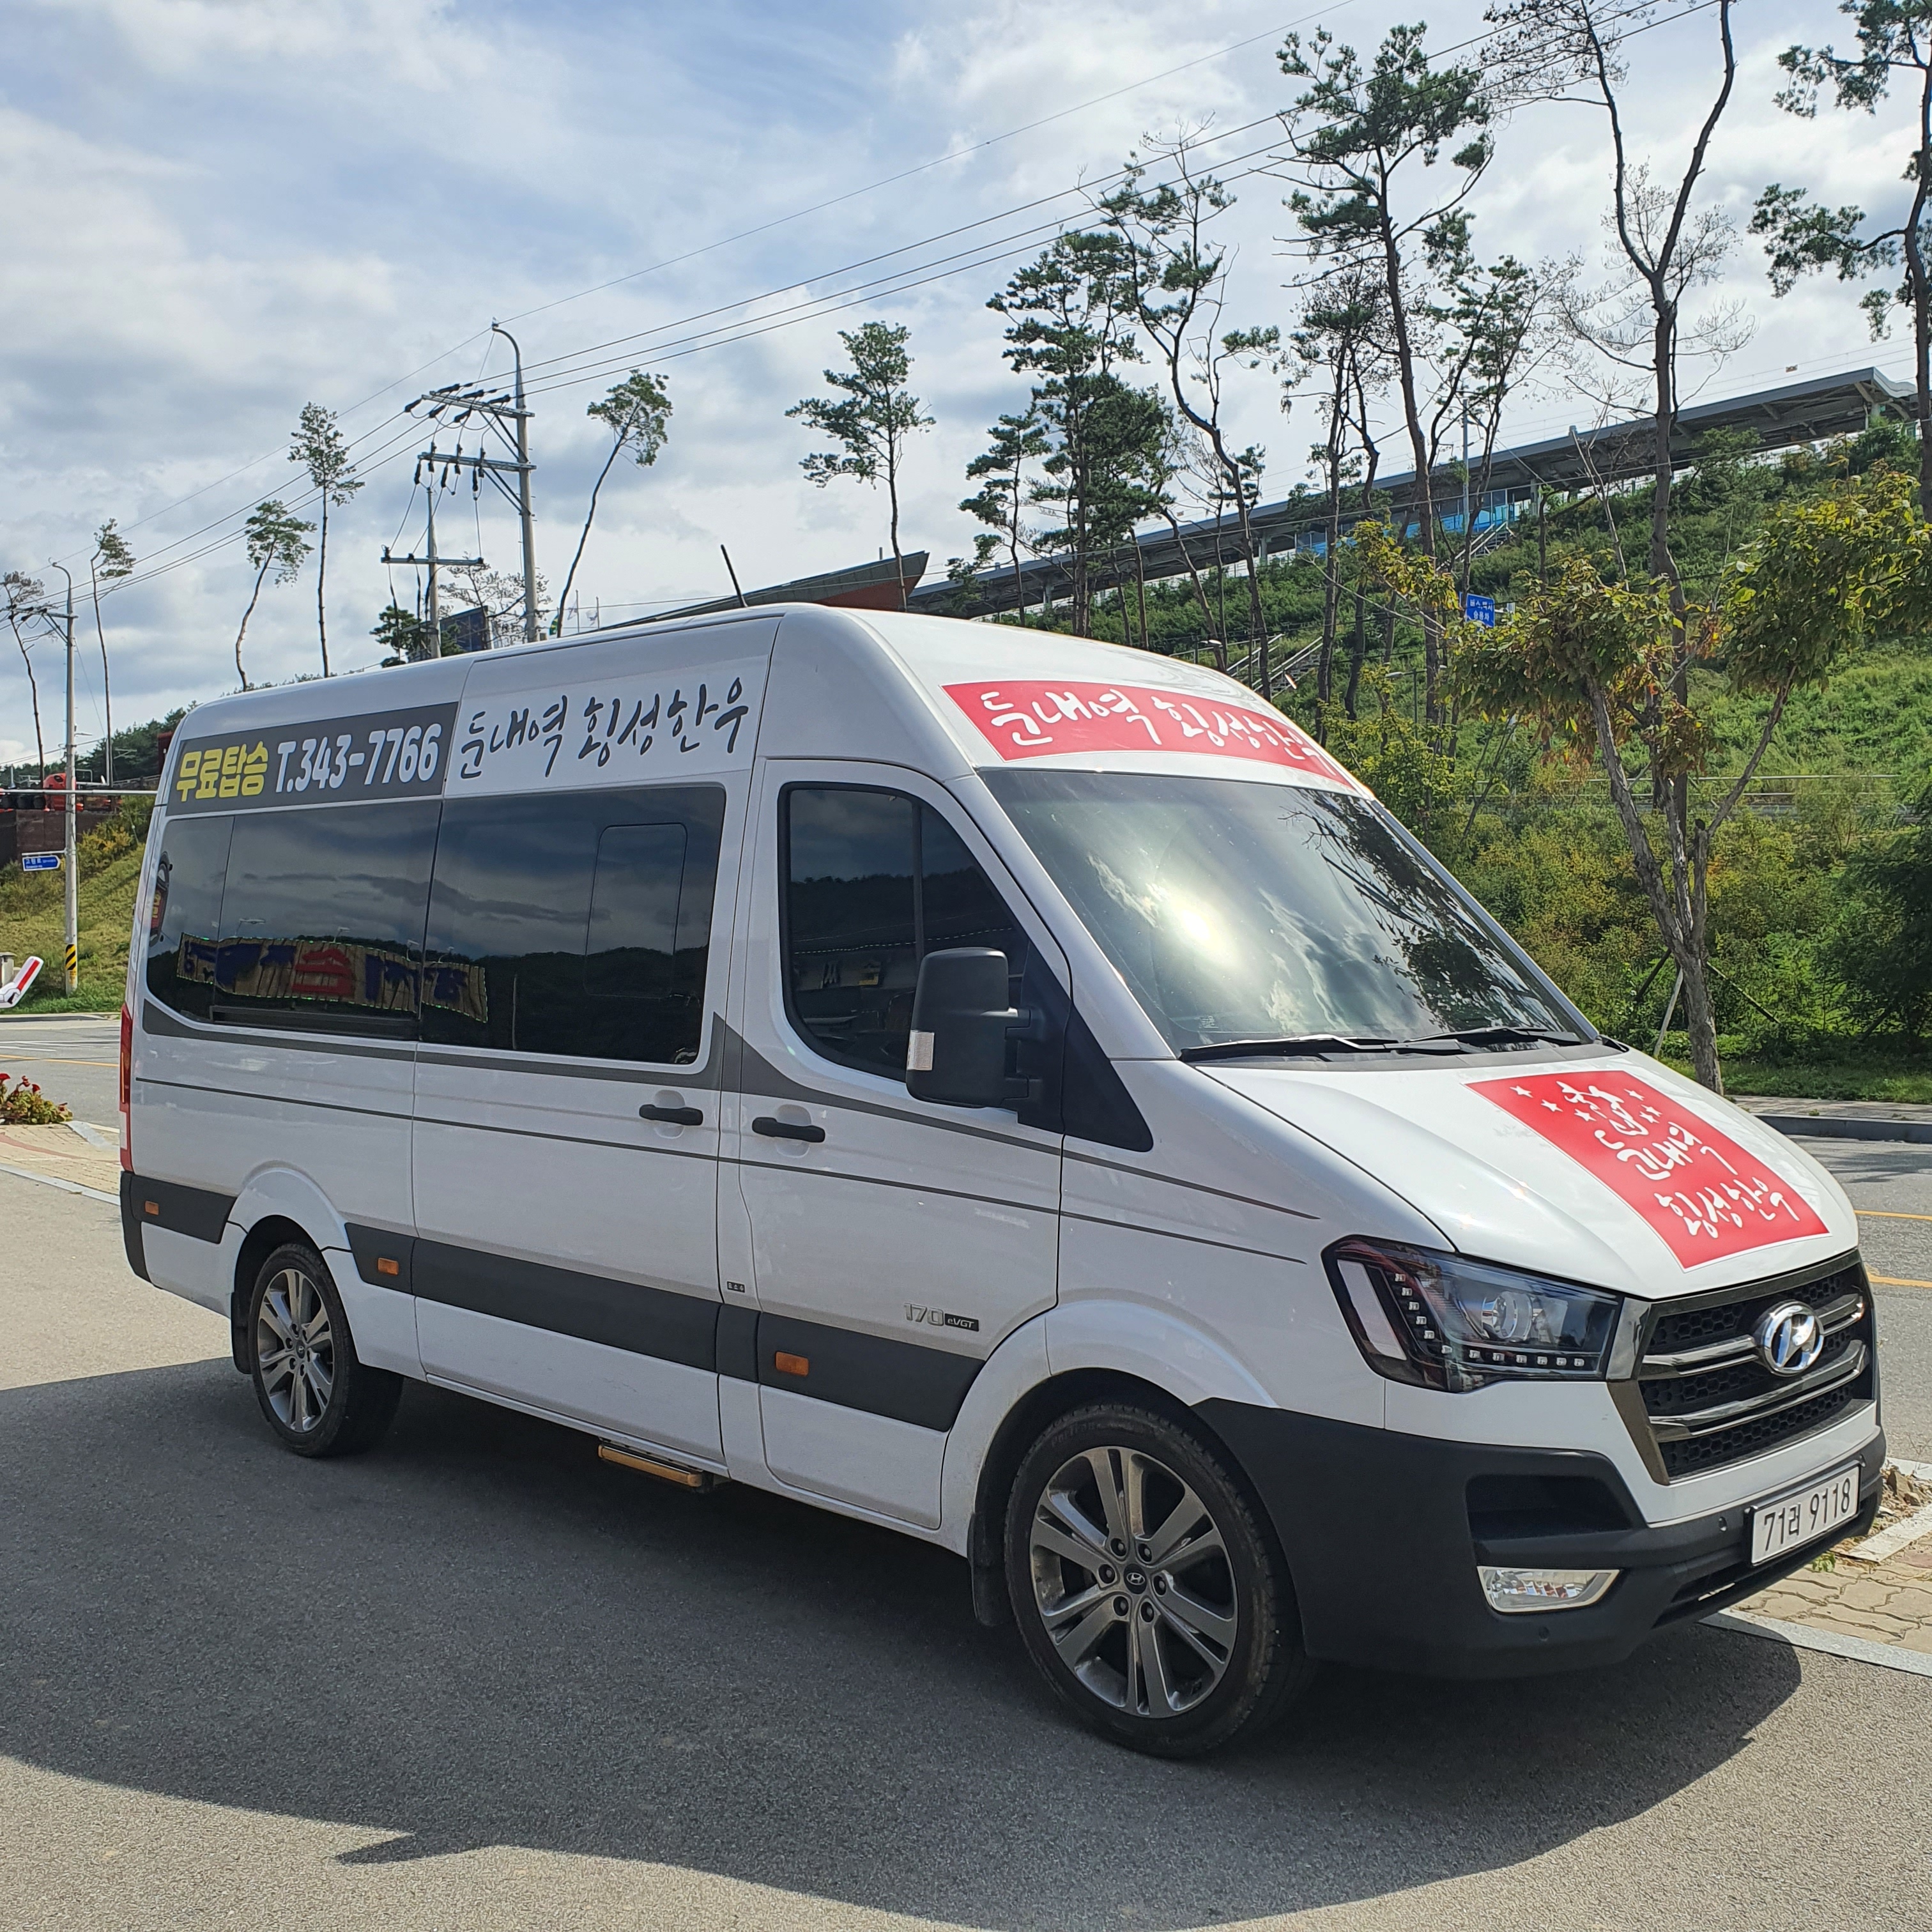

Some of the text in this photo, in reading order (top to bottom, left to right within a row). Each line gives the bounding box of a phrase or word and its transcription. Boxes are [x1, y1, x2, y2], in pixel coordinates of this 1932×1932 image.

[1473, 610, 1489, 622] 승용차
[461, 695, 568, 779] 둔내역
[981, 689, 1162, 746] 둔내역
[176, 723, 442, 802] 무료탑승 T.343-7766
[1594, 1121, 1738, 1181] 둔내역
[904, 1303, 974, 1328] 170 eVGT
[1764, 1477, 1851, 1552] 71러 9118
